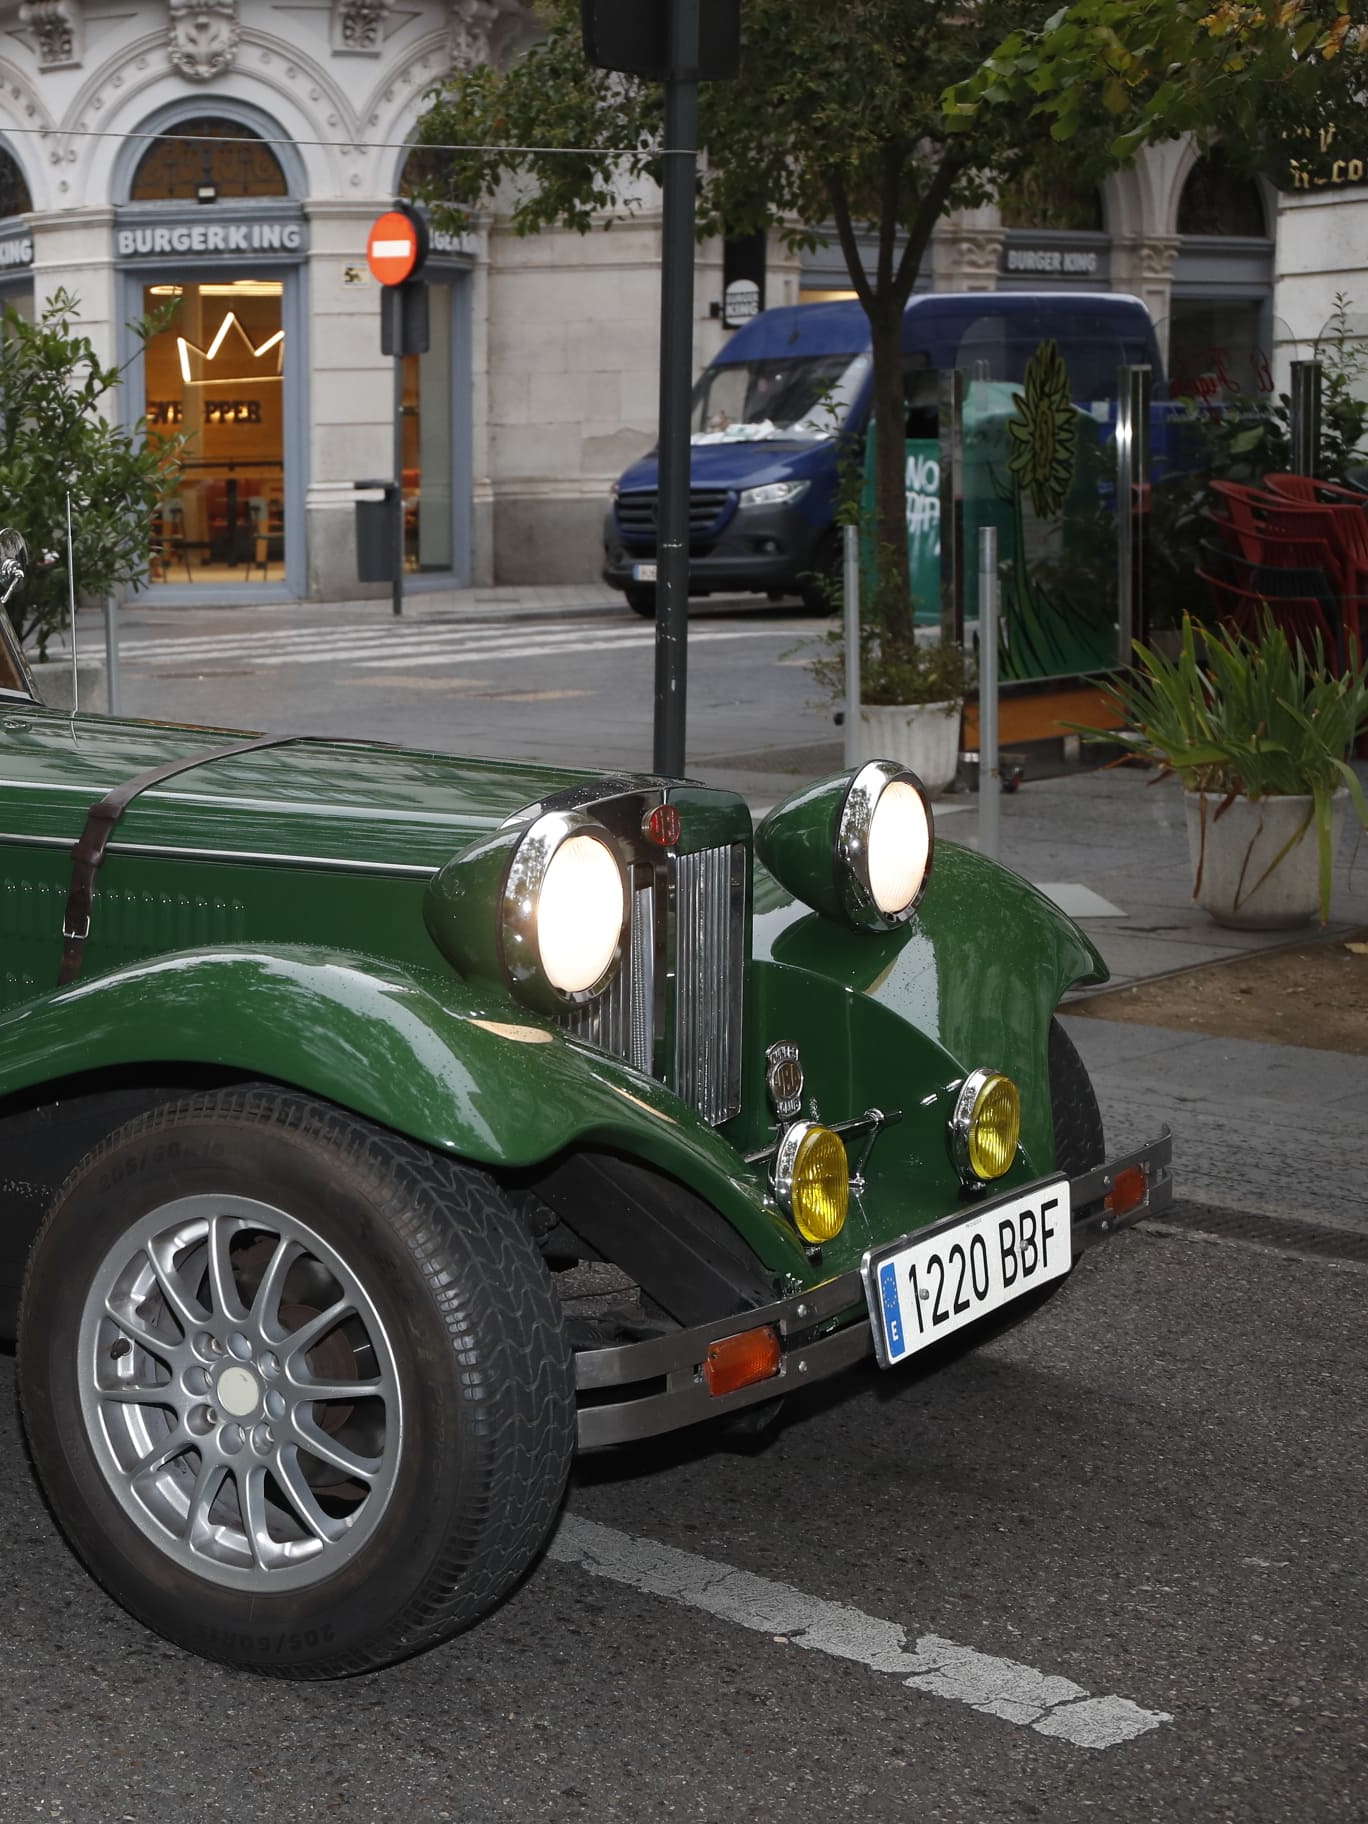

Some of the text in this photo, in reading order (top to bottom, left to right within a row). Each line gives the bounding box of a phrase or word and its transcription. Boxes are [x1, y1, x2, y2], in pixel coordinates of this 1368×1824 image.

[118, 223, 301, 254] BURGER KING
[1007, 249, 1097, 273] BURGER KING
[147, 400, 263, 424] WHPPER
[904, 453, 941, 494] NO
[908, 1198, 1059, 1334] 1220 BBF
[891, 1320, 899, 1342] E
